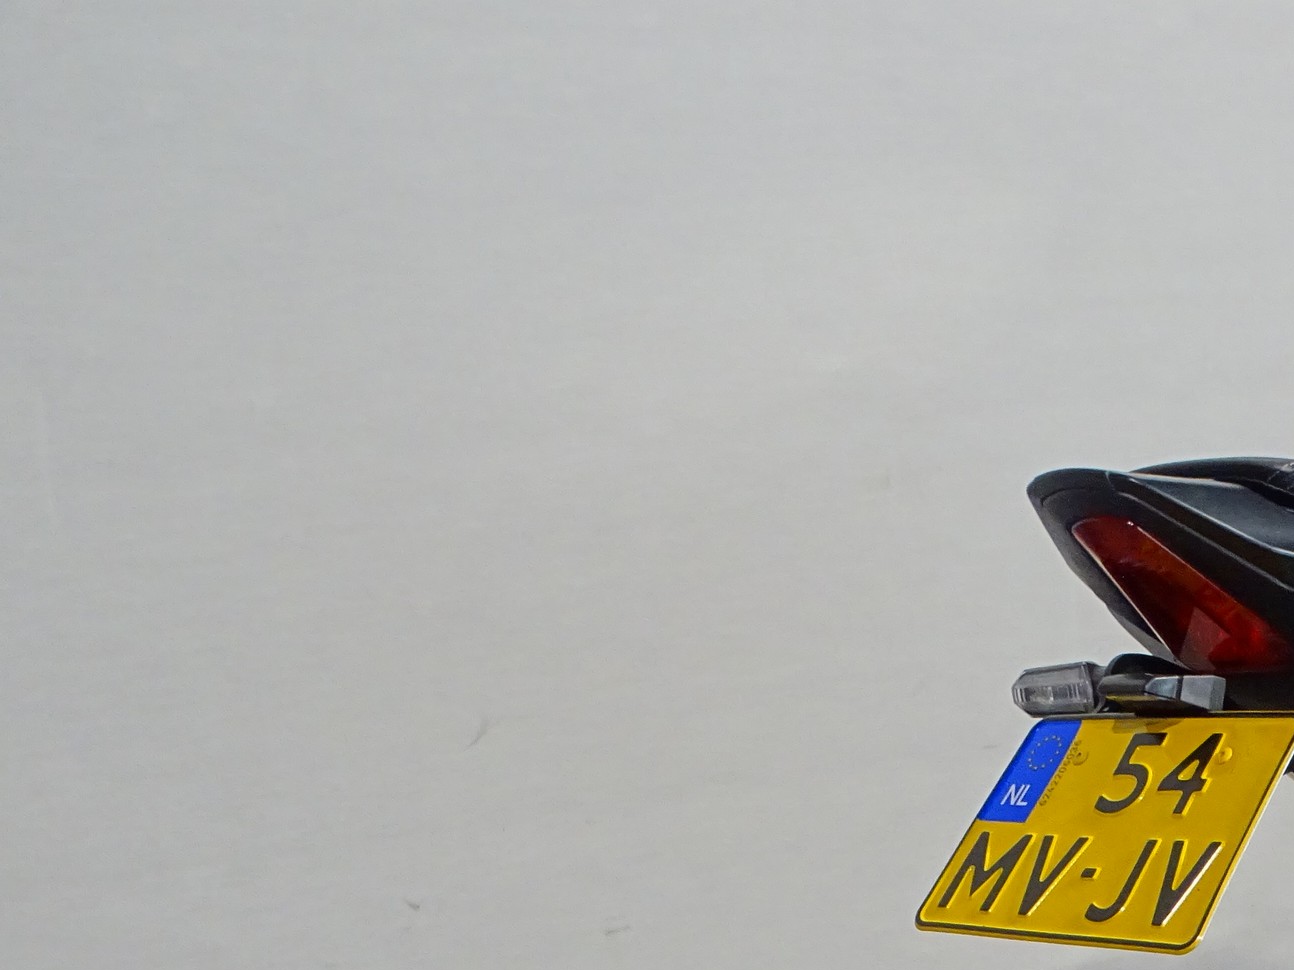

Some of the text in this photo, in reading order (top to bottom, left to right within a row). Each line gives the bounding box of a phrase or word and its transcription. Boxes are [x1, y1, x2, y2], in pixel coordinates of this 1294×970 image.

[1000, 783, 1029, 807] NL
[1094, 732, 1225, 815] 54
[937, 831, 1224, 927] MV-JV
